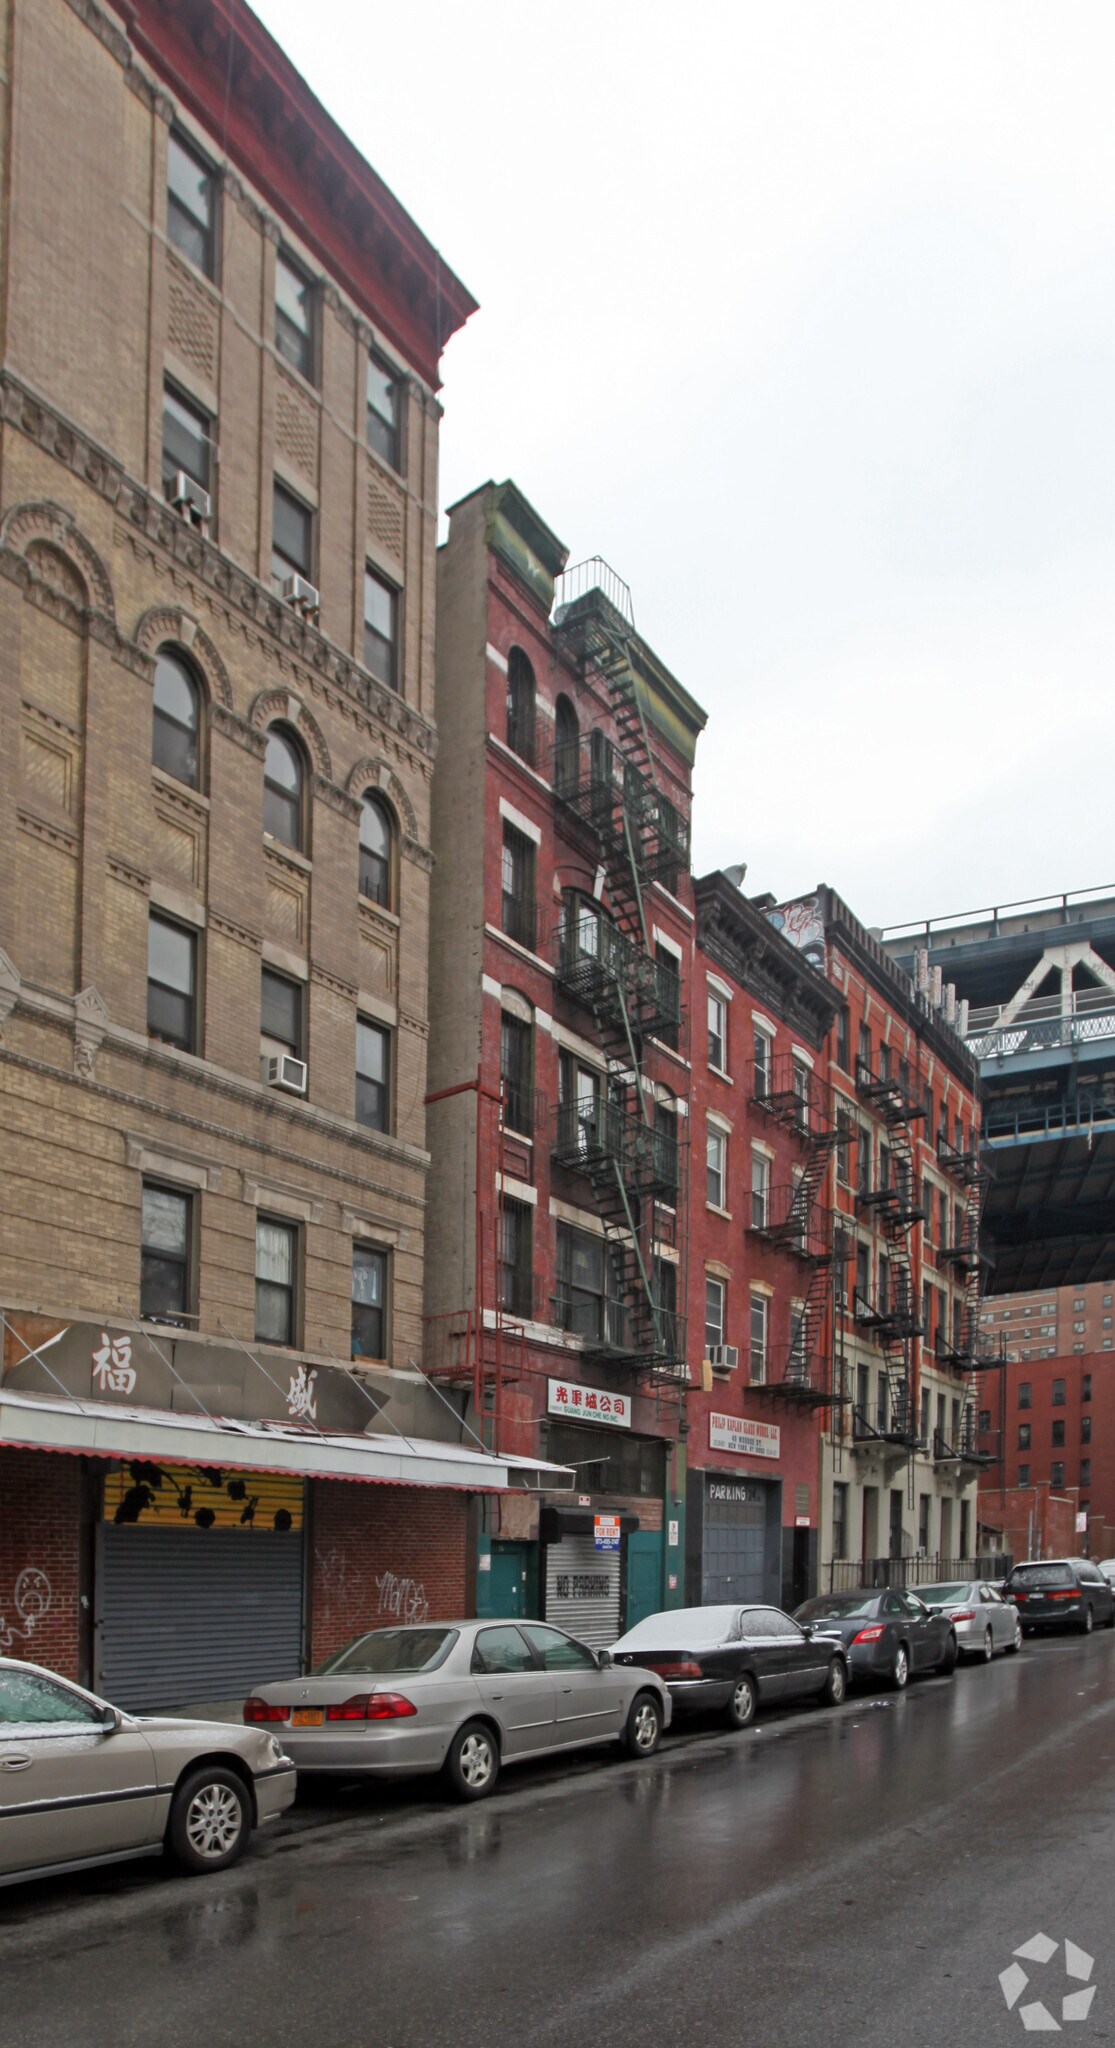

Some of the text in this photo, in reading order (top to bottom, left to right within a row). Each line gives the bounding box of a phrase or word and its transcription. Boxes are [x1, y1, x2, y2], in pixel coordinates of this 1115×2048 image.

[92, 1332, 137, 1395] 福
[564, 1406, 581, 1416] GUANG
[709, 1484, 746, 1501] PARKING
[596, 1528, 618, 1536] FOR RENT
[556, 1575, 609, 1598] NO PARKING
